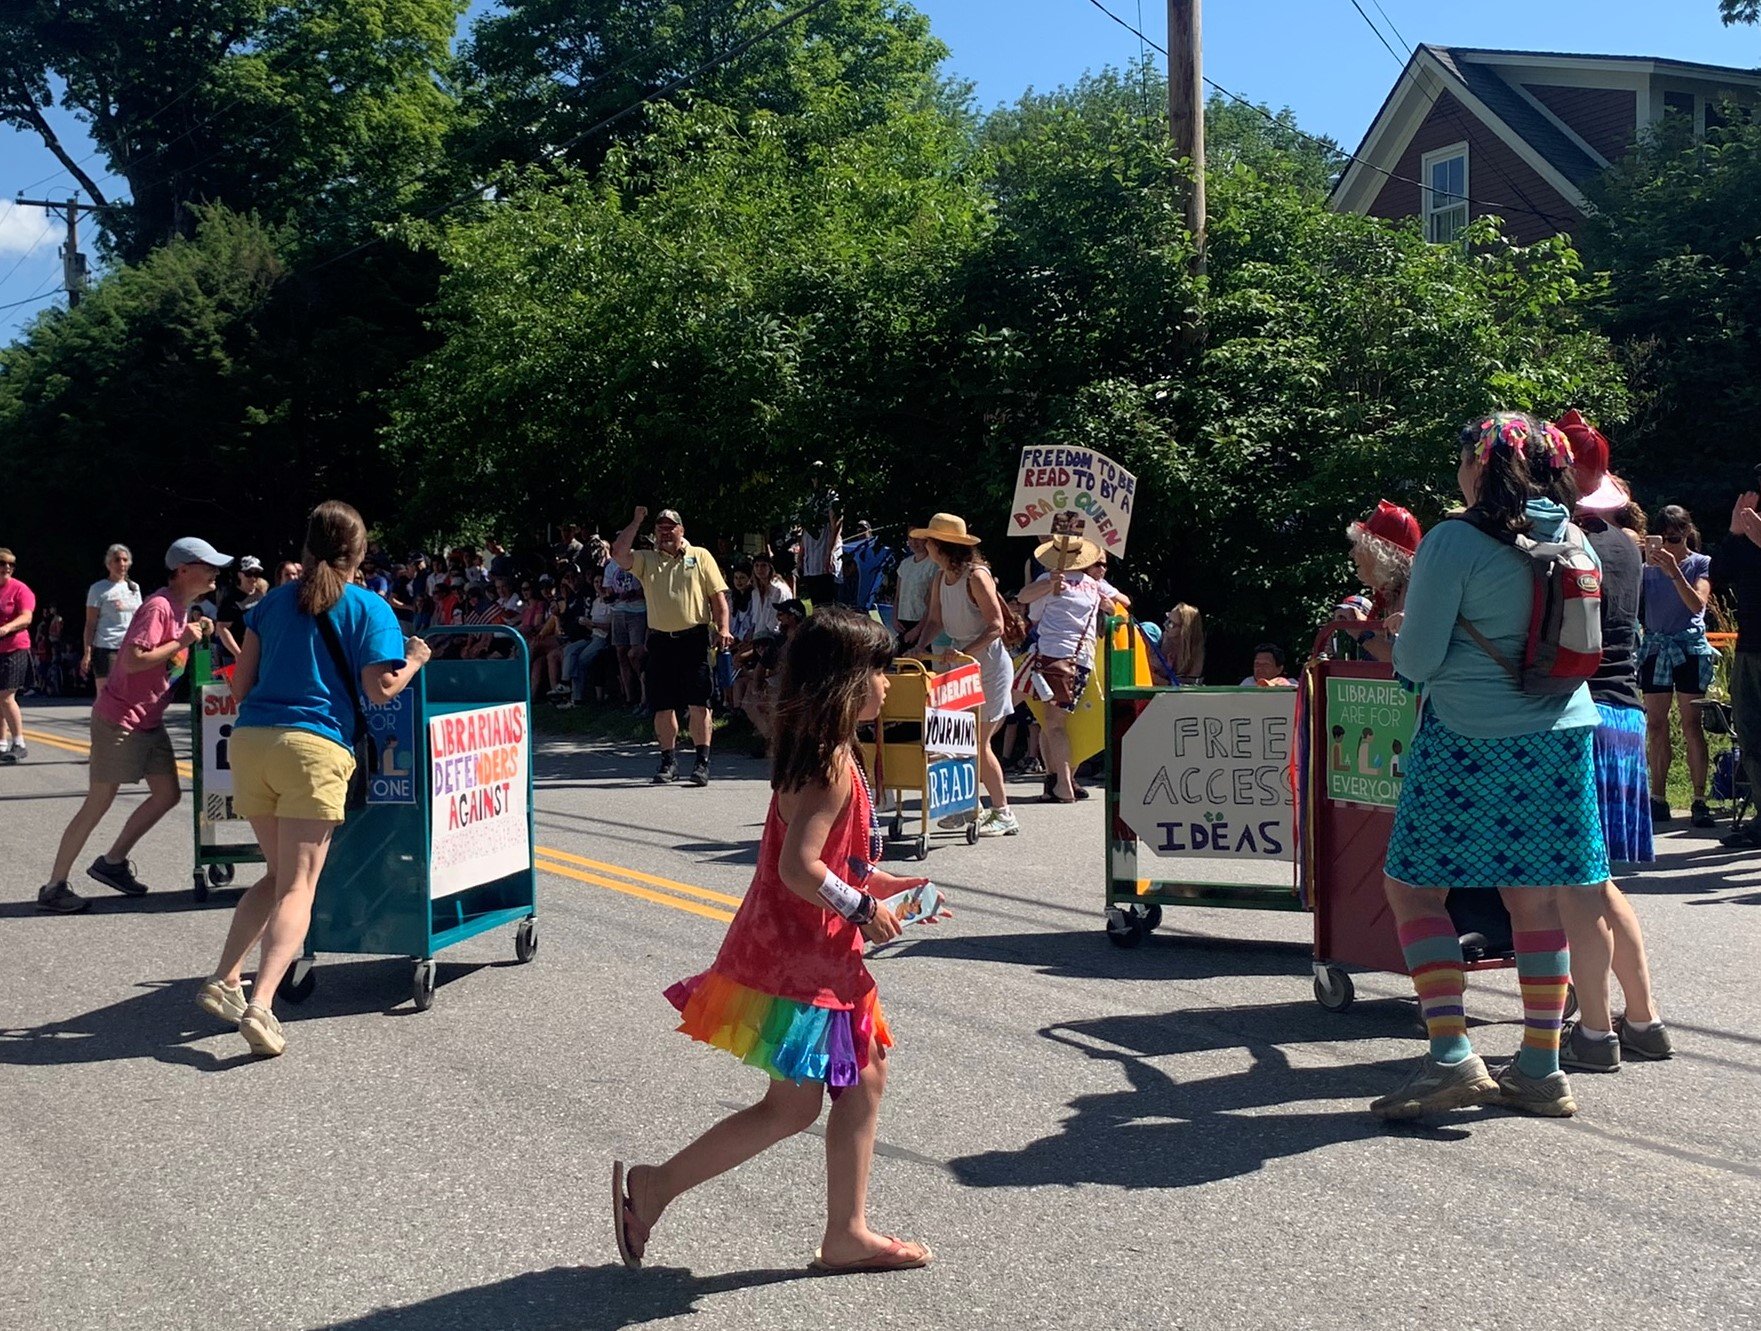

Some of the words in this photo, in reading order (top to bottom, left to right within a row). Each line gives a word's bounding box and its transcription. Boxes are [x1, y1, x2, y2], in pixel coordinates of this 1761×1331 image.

[1022, 449, 1093, 469] FREEDOM
[1098, 457, 1116, 481] TO
[1118, 470, 1135, 495] BE
[1024, 467, 1071, 487] READ
[1073, 469, 1095, 491] TO
[1100, 479, 1118, 503] BY
[1120, 494, 1130, 514] A
[1013, 490, 1069, 529] DRAG
[1074, 491, 1122, 547] QUEEN
[929, 672, 981, 707] LIBERATE
[1337, 684, 1407, 706] LIBRARIES
[1174, 717, 1288, 760] FREE
[1340, 706, 1366, 725] ARE
[1370, 707, 1401, 727] FOR
[435, 745, 519, 797] DEFENDERS
[929, 763, 976, 809] READ
[1333, 774, 1403, 800] EVERYON
[449, 782, 510, 831] AGAINST
[1157, 821, 1282, 854] IDEAS
